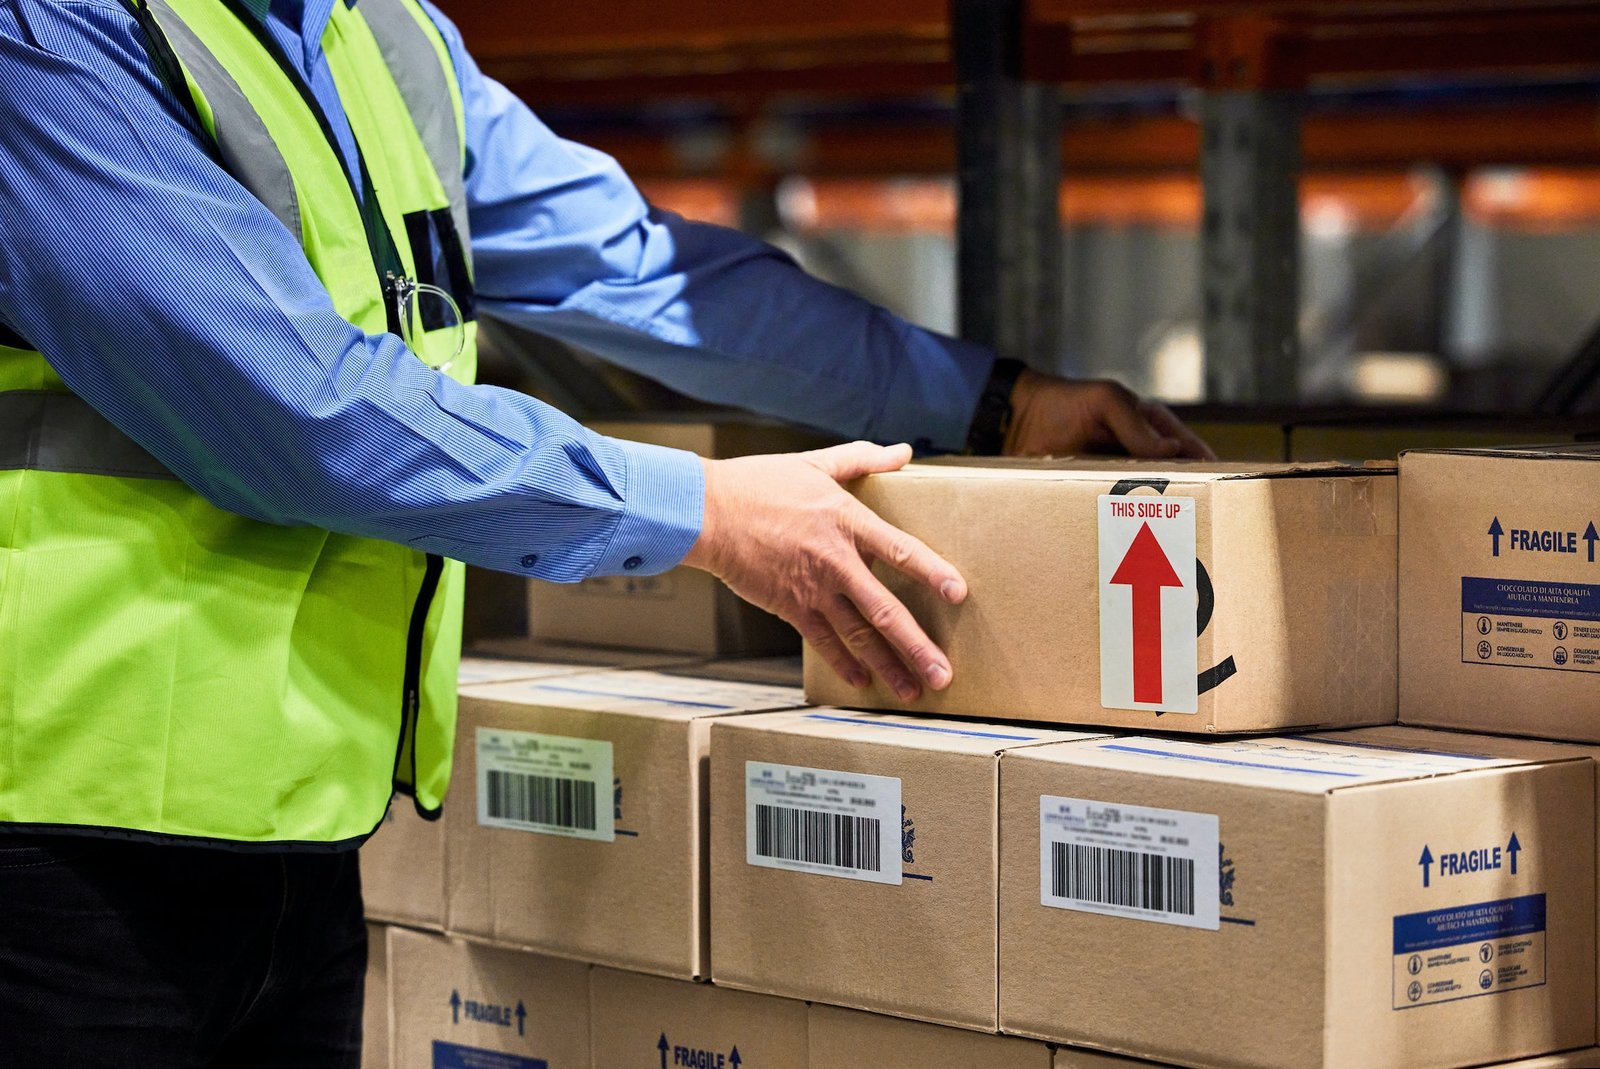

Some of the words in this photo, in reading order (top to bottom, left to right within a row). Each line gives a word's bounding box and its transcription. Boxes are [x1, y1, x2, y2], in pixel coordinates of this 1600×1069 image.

[1111, 502, 1135, 517] THIS
[1138, 502, 1162, 518] SIDE
[1166, 503, 1180, 519] UP
[1511, 529, 1577, 553] FRAGILE
[1497, 584, 1538, 594] CIOCCOLATO
[1540, 586, 1547, 594] DI
[1548, 587, 1561, 595] ALTA
[1507, 593, 1532, 601] AIUTACI
[1538, 595, 1579, 604] MANTENERLA
[1441, 847, 1502, 876] FRAGILE
[465, 1000, 511, 1027] FRAGILE
[674, 1045, 725, 1069] FRAGILE
